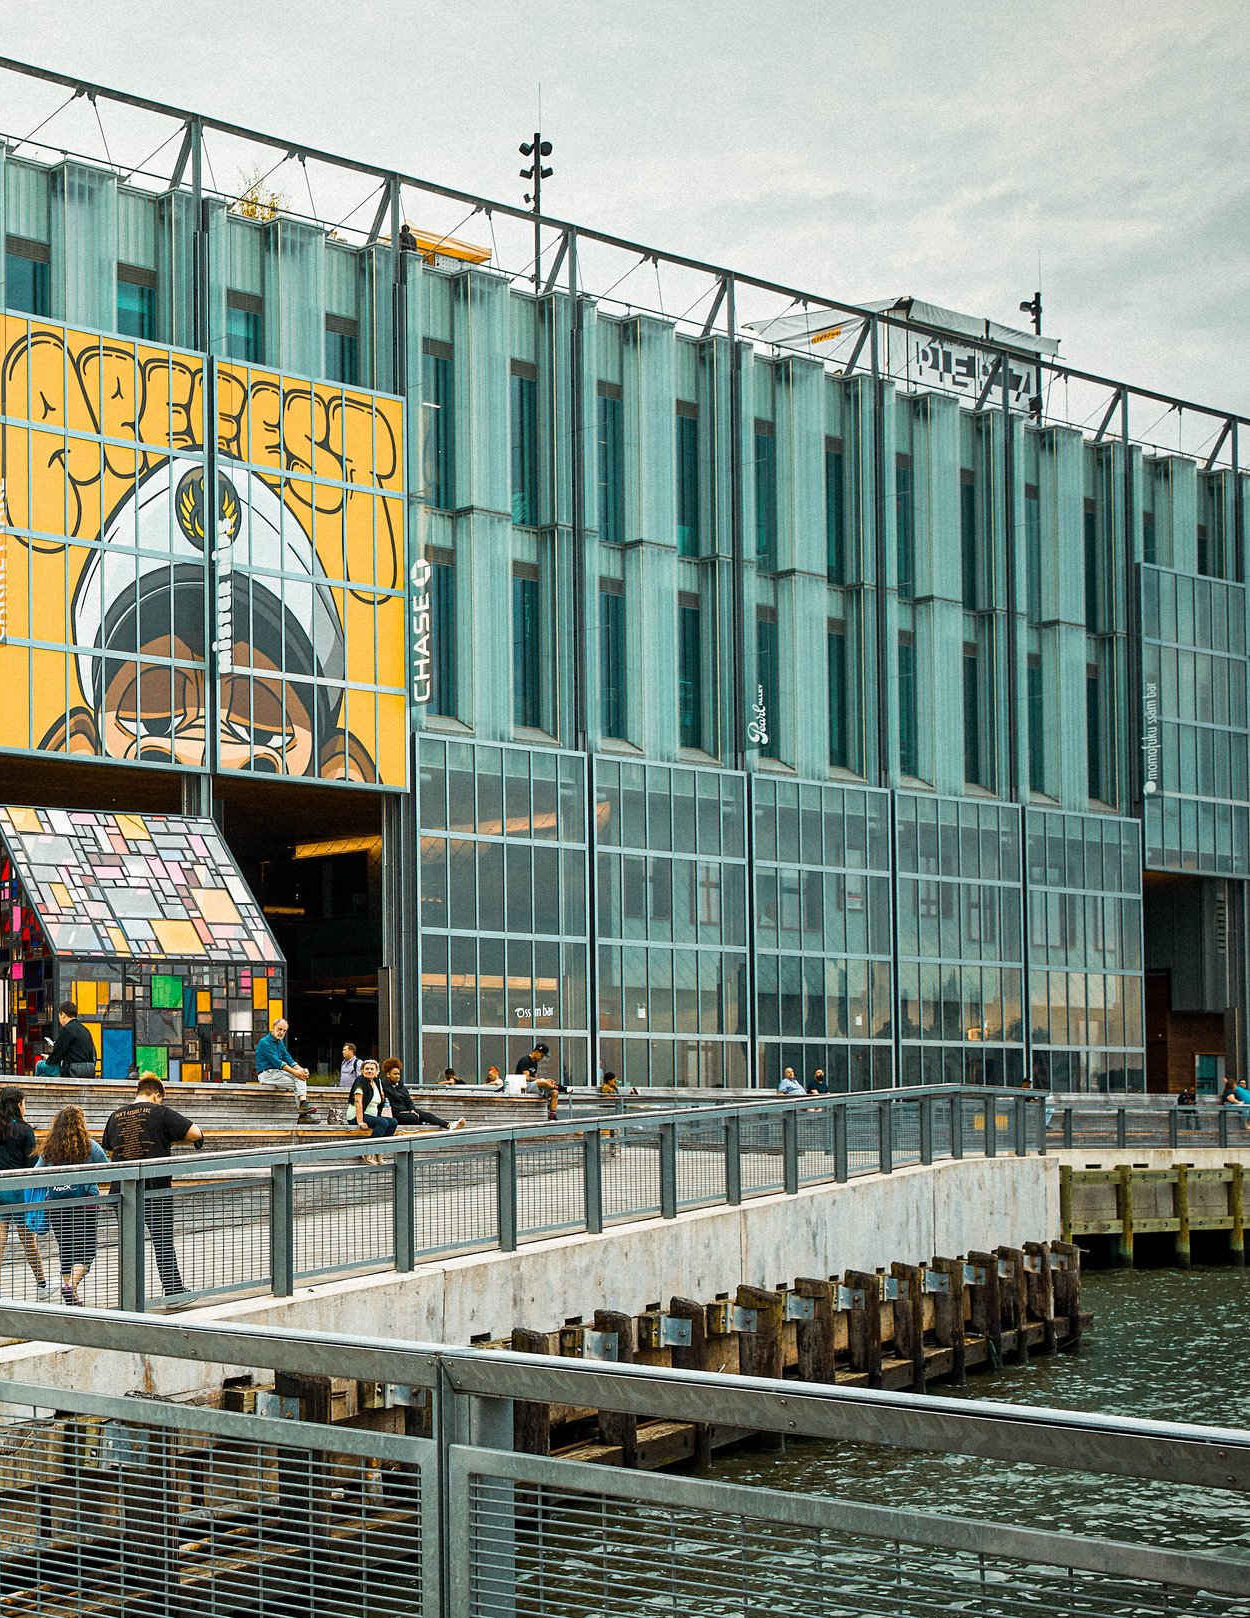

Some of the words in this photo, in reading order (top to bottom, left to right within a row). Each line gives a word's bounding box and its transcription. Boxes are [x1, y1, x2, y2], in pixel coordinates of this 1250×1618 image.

[413, 592, 431, 702] CHASE
[1142, 682, 1157, 699] bar
[747, 704, 769, 745] Pearl
[1141, 726, 1162, 780] momofuku
[543, 1003, 554, 1017] bar
